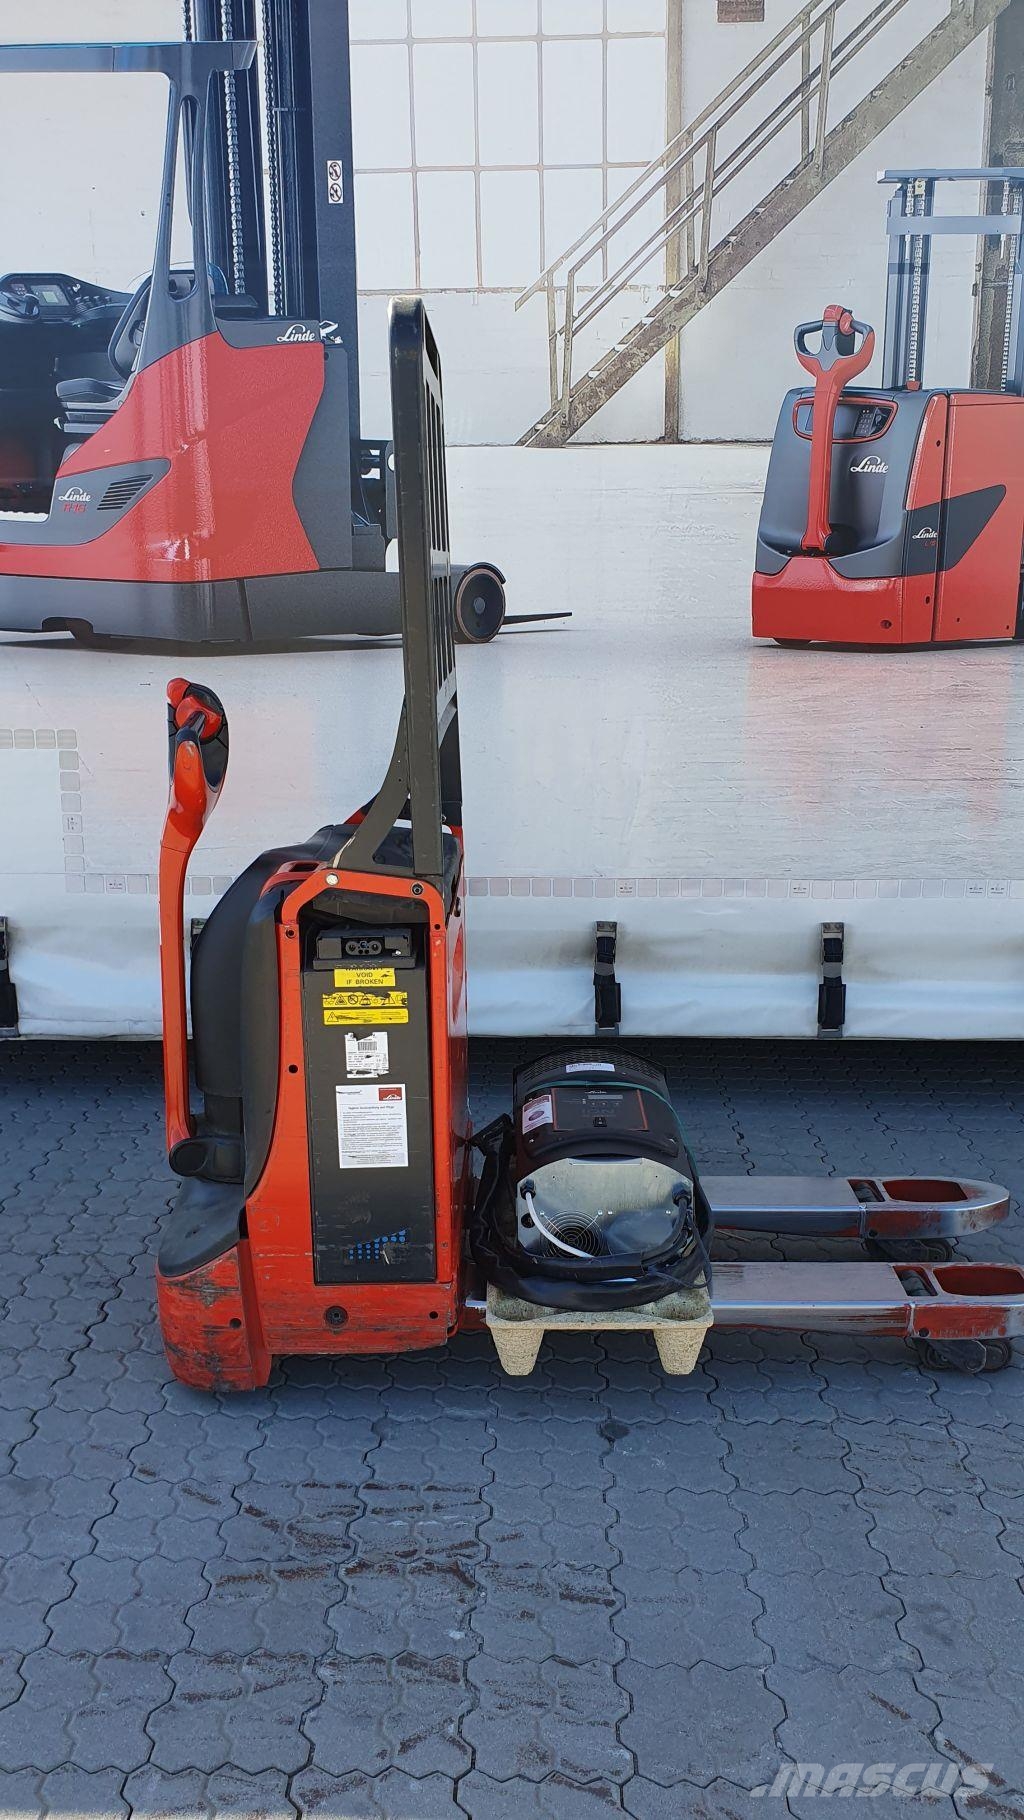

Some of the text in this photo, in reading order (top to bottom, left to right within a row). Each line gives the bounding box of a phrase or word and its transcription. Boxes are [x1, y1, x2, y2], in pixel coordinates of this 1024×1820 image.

[276, 324, 316, 342] Linde
[850, 455, 889, 474] Linde
[58, 486, 91, 502] Linde
[912, 527, 938, 539] Linde
